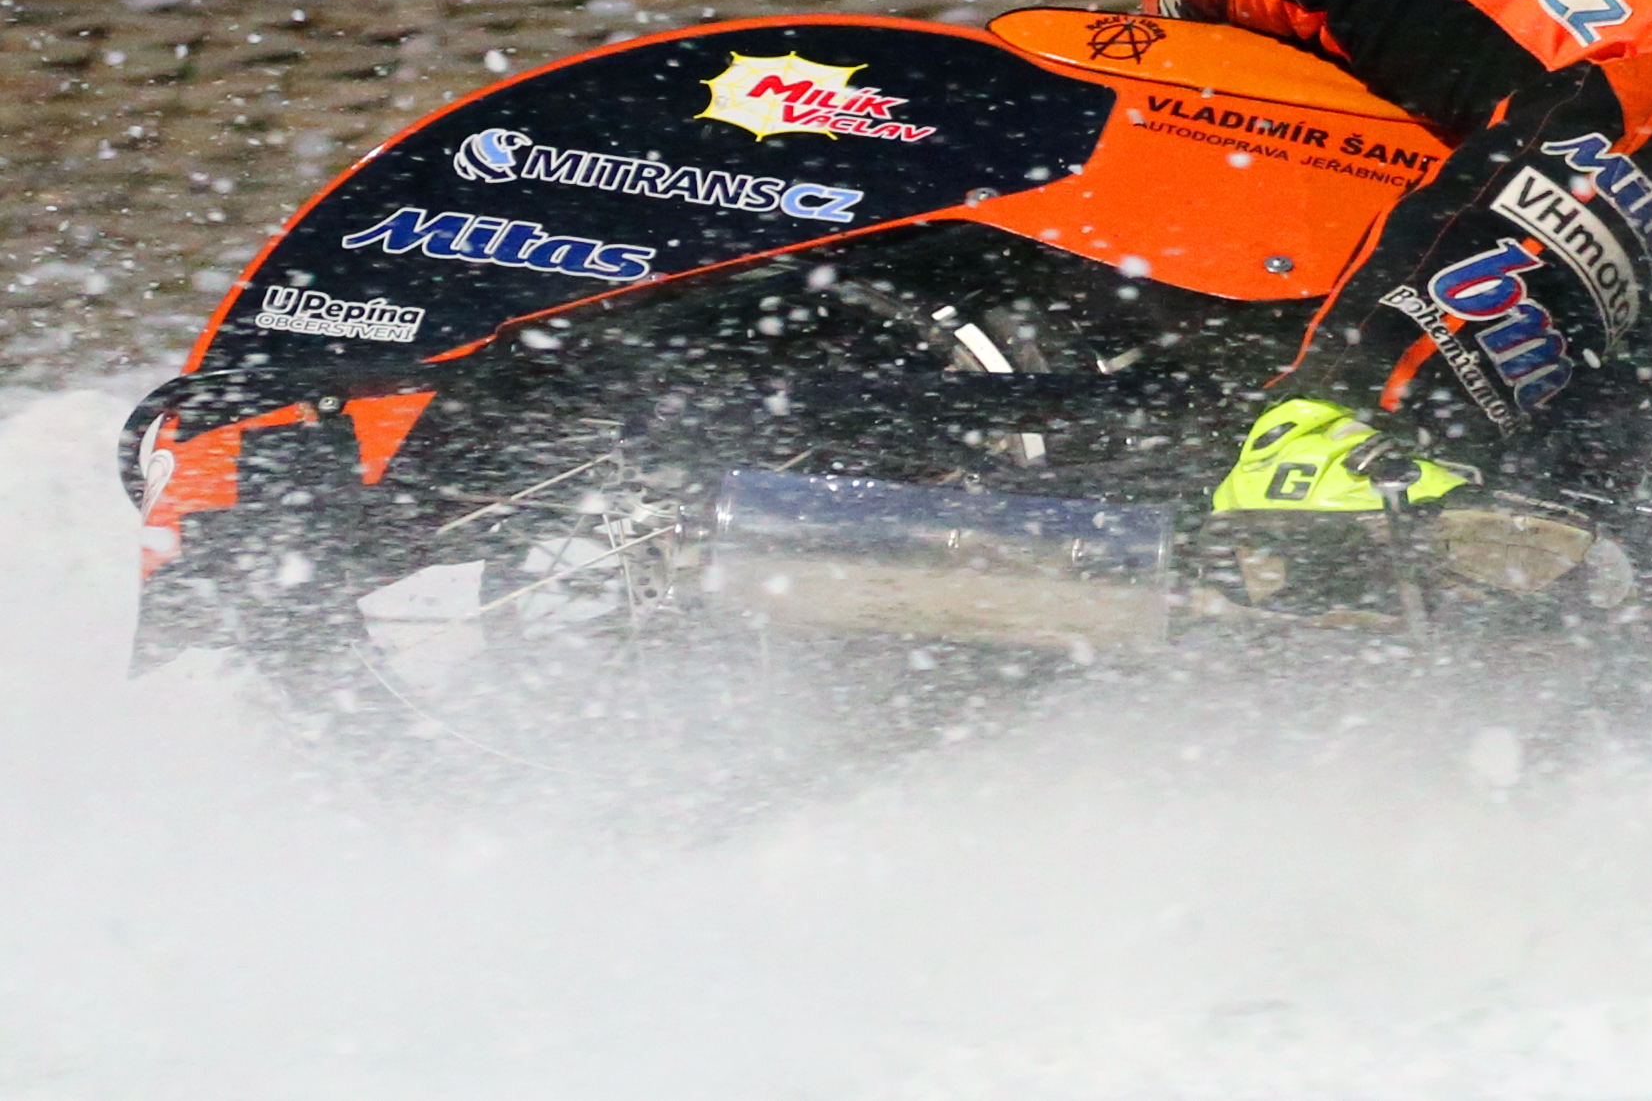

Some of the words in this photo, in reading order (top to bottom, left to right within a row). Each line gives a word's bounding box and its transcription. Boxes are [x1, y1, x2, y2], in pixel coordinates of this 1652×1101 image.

[1133, 120, 1289, 161] AUTODOPRAVA
[1147, 95, 1329, 149] VLADIMÍR
[342, 207, 656, 281] Mitas
[256, 312, 414, 342] OBČERSTVENÍ
[263, 285, 298, 313] U
[301, 291, 424, 327] Pepína
[1428, 238, 1574, 414] bm
[1265, 463, 1317, 501] G
